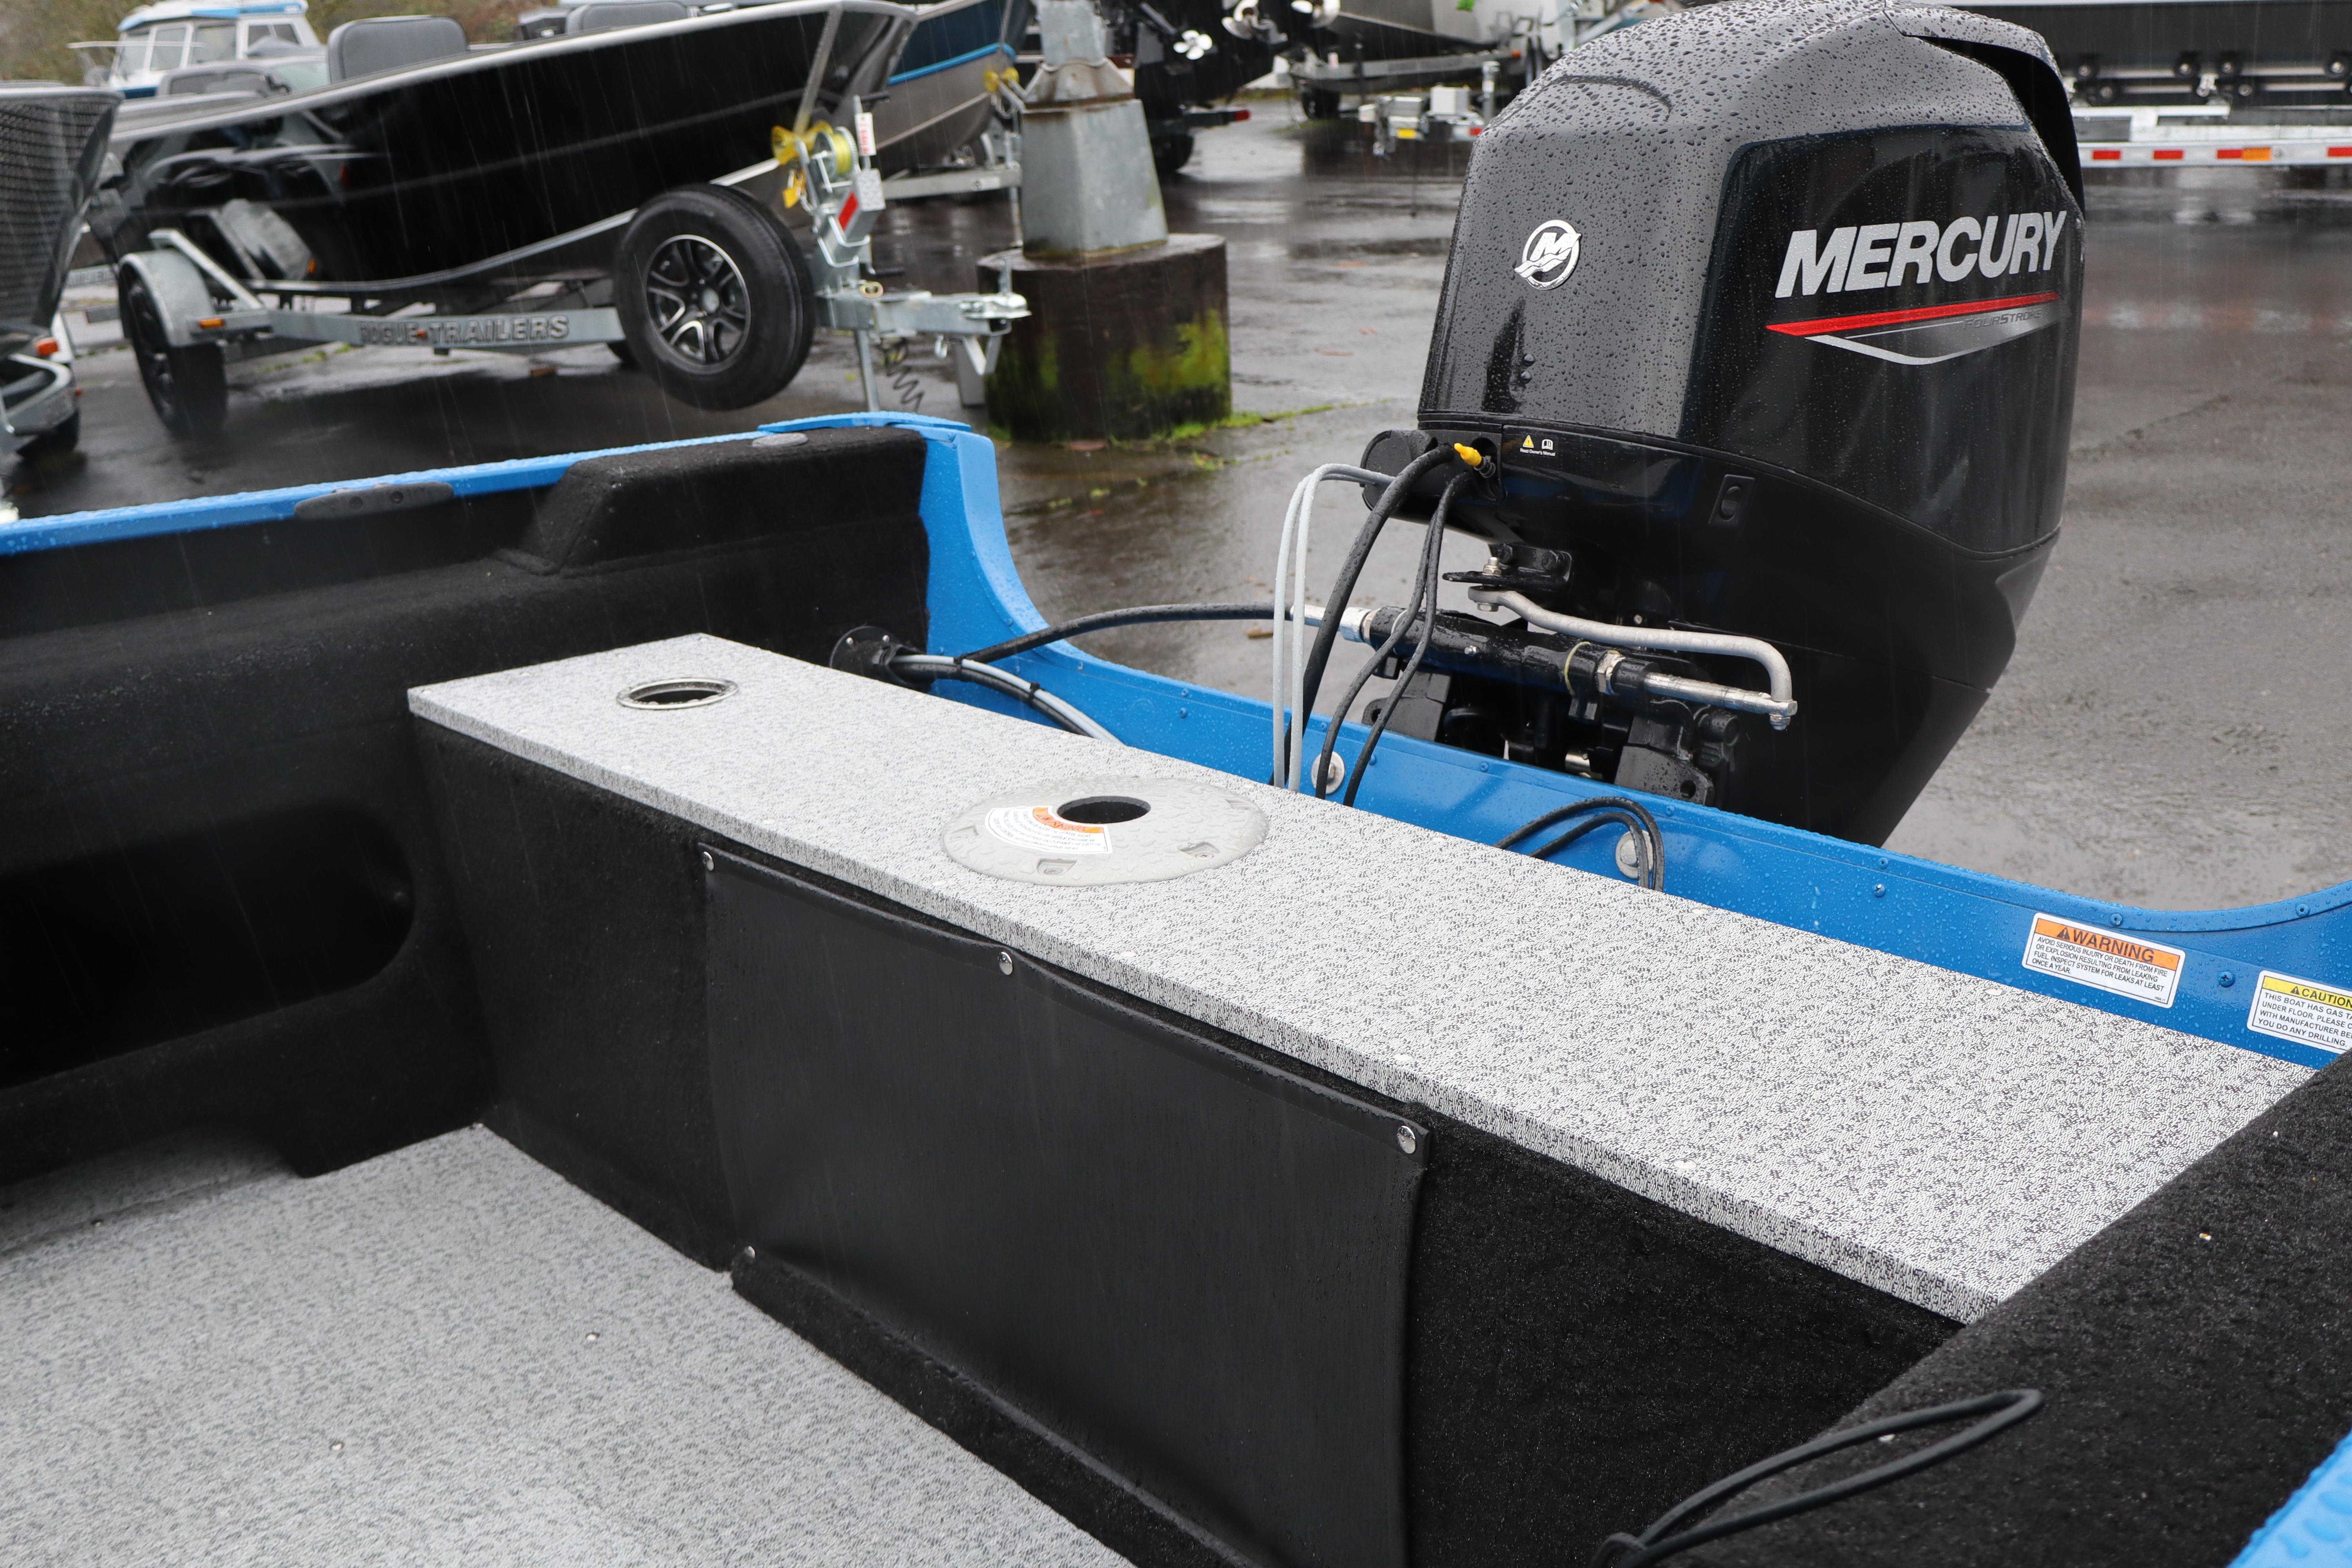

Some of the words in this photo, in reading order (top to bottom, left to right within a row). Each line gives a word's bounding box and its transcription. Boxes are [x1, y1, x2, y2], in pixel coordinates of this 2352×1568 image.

[1775, 211, 2066, 298] MERCURY
[429, 314, 569, 344] TRAILERS
[2038, 936, 2055, 946] AVOID
[2056, 942, 2081, 953] SERIOUS
[2083, 948, 2104, 959] INJURY
[2114, 957, 2134, 967] DEATH
[2136, 963, 2153, 973] FROM
[2154, 968, 2168, 977] FIRE
[2074, 929, 2154, 963] WARNING
[2032, 958, 2049, 967] ONCE
[2045, 946, 2078, 961] EXPLOSION
[2079, 956, 2112, 969] RESULTING
[2113, 965, 2130, 975] FROM
[2131, 971, 2158, 982] LEAKING
[2051, 956, 2076, 967] INSPECT
[2076, 963, 2100, 974] SYSTEM
[2115, 974, 2135, 984] LEAKS
[2144, 981, 2165, 991] LEAST
[2265, 992, 2282, 1002] THIS
[2284, 998, 2306, 1007] BOAT
[2307, 1004, 2324, 1012] HAS
[2326, 1008, 2343, 1017] GAS
[2302, 989, 2352, 1008] CAUTION
[2260, 1009, 2278, 1019] WITH
[2279, 1015, 2339, 1035] MANUFACTURER
[2262, 1001, 2287, 1013] UNDER
[2288, 1008, 2314, 1019] FLOOR.
[2317, 1015, 2346, 1027] PLEASE
[2258, 1018, 2274, 1027] YOU
[2308, 1032, 2347, 1047] DRILLING.
